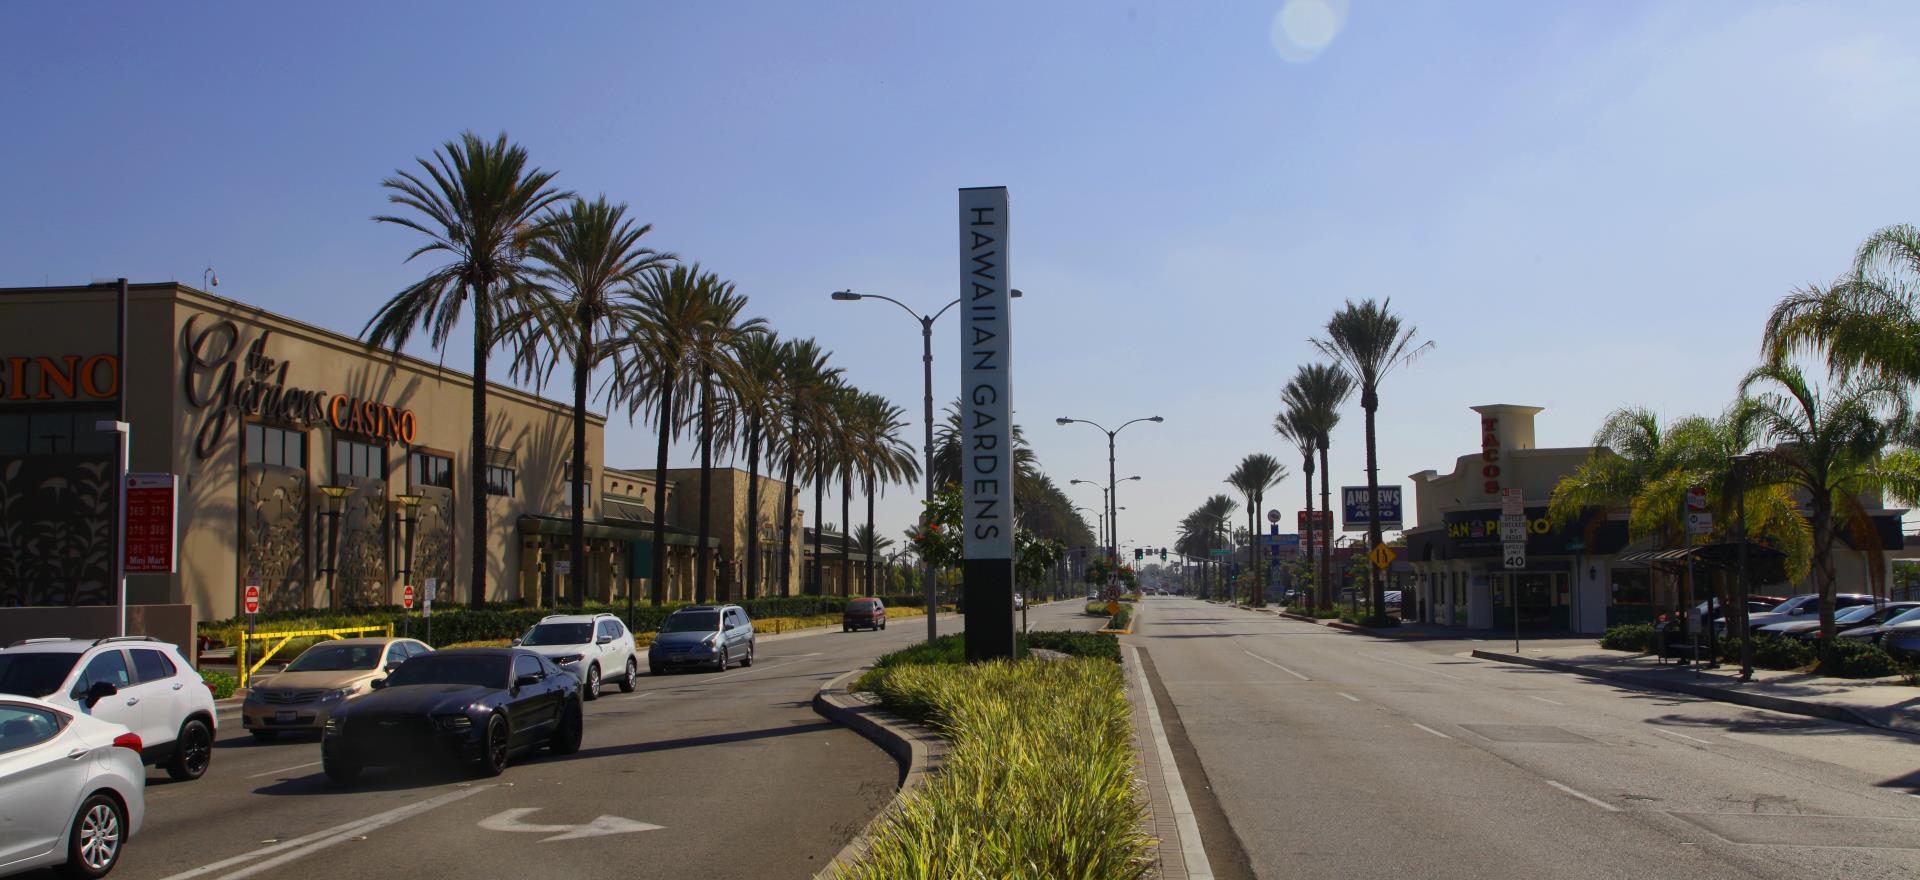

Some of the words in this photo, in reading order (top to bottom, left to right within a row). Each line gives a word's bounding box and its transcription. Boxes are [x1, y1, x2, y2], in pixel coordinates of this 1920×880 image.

[970, 207, 997, 370] HAWAIIAN
[246, 329, 278, 375] the
[0, 354, 117, 400] INO
[182, 313, 328, 460] Gardens
[331, 393, 417, 444] CASINO
[972, 384, 999, 540] GARDENS
[1482, 418, 1500, 494] TACOS
[1346, 490, 1400, 506] ANDEWS
[1448, 521, 1469, 538] SAN
[1486, 518, 1550, 536] PRO
[147, 555, 166, 565] Mart
[1505, 556, 1524, 566] 40
